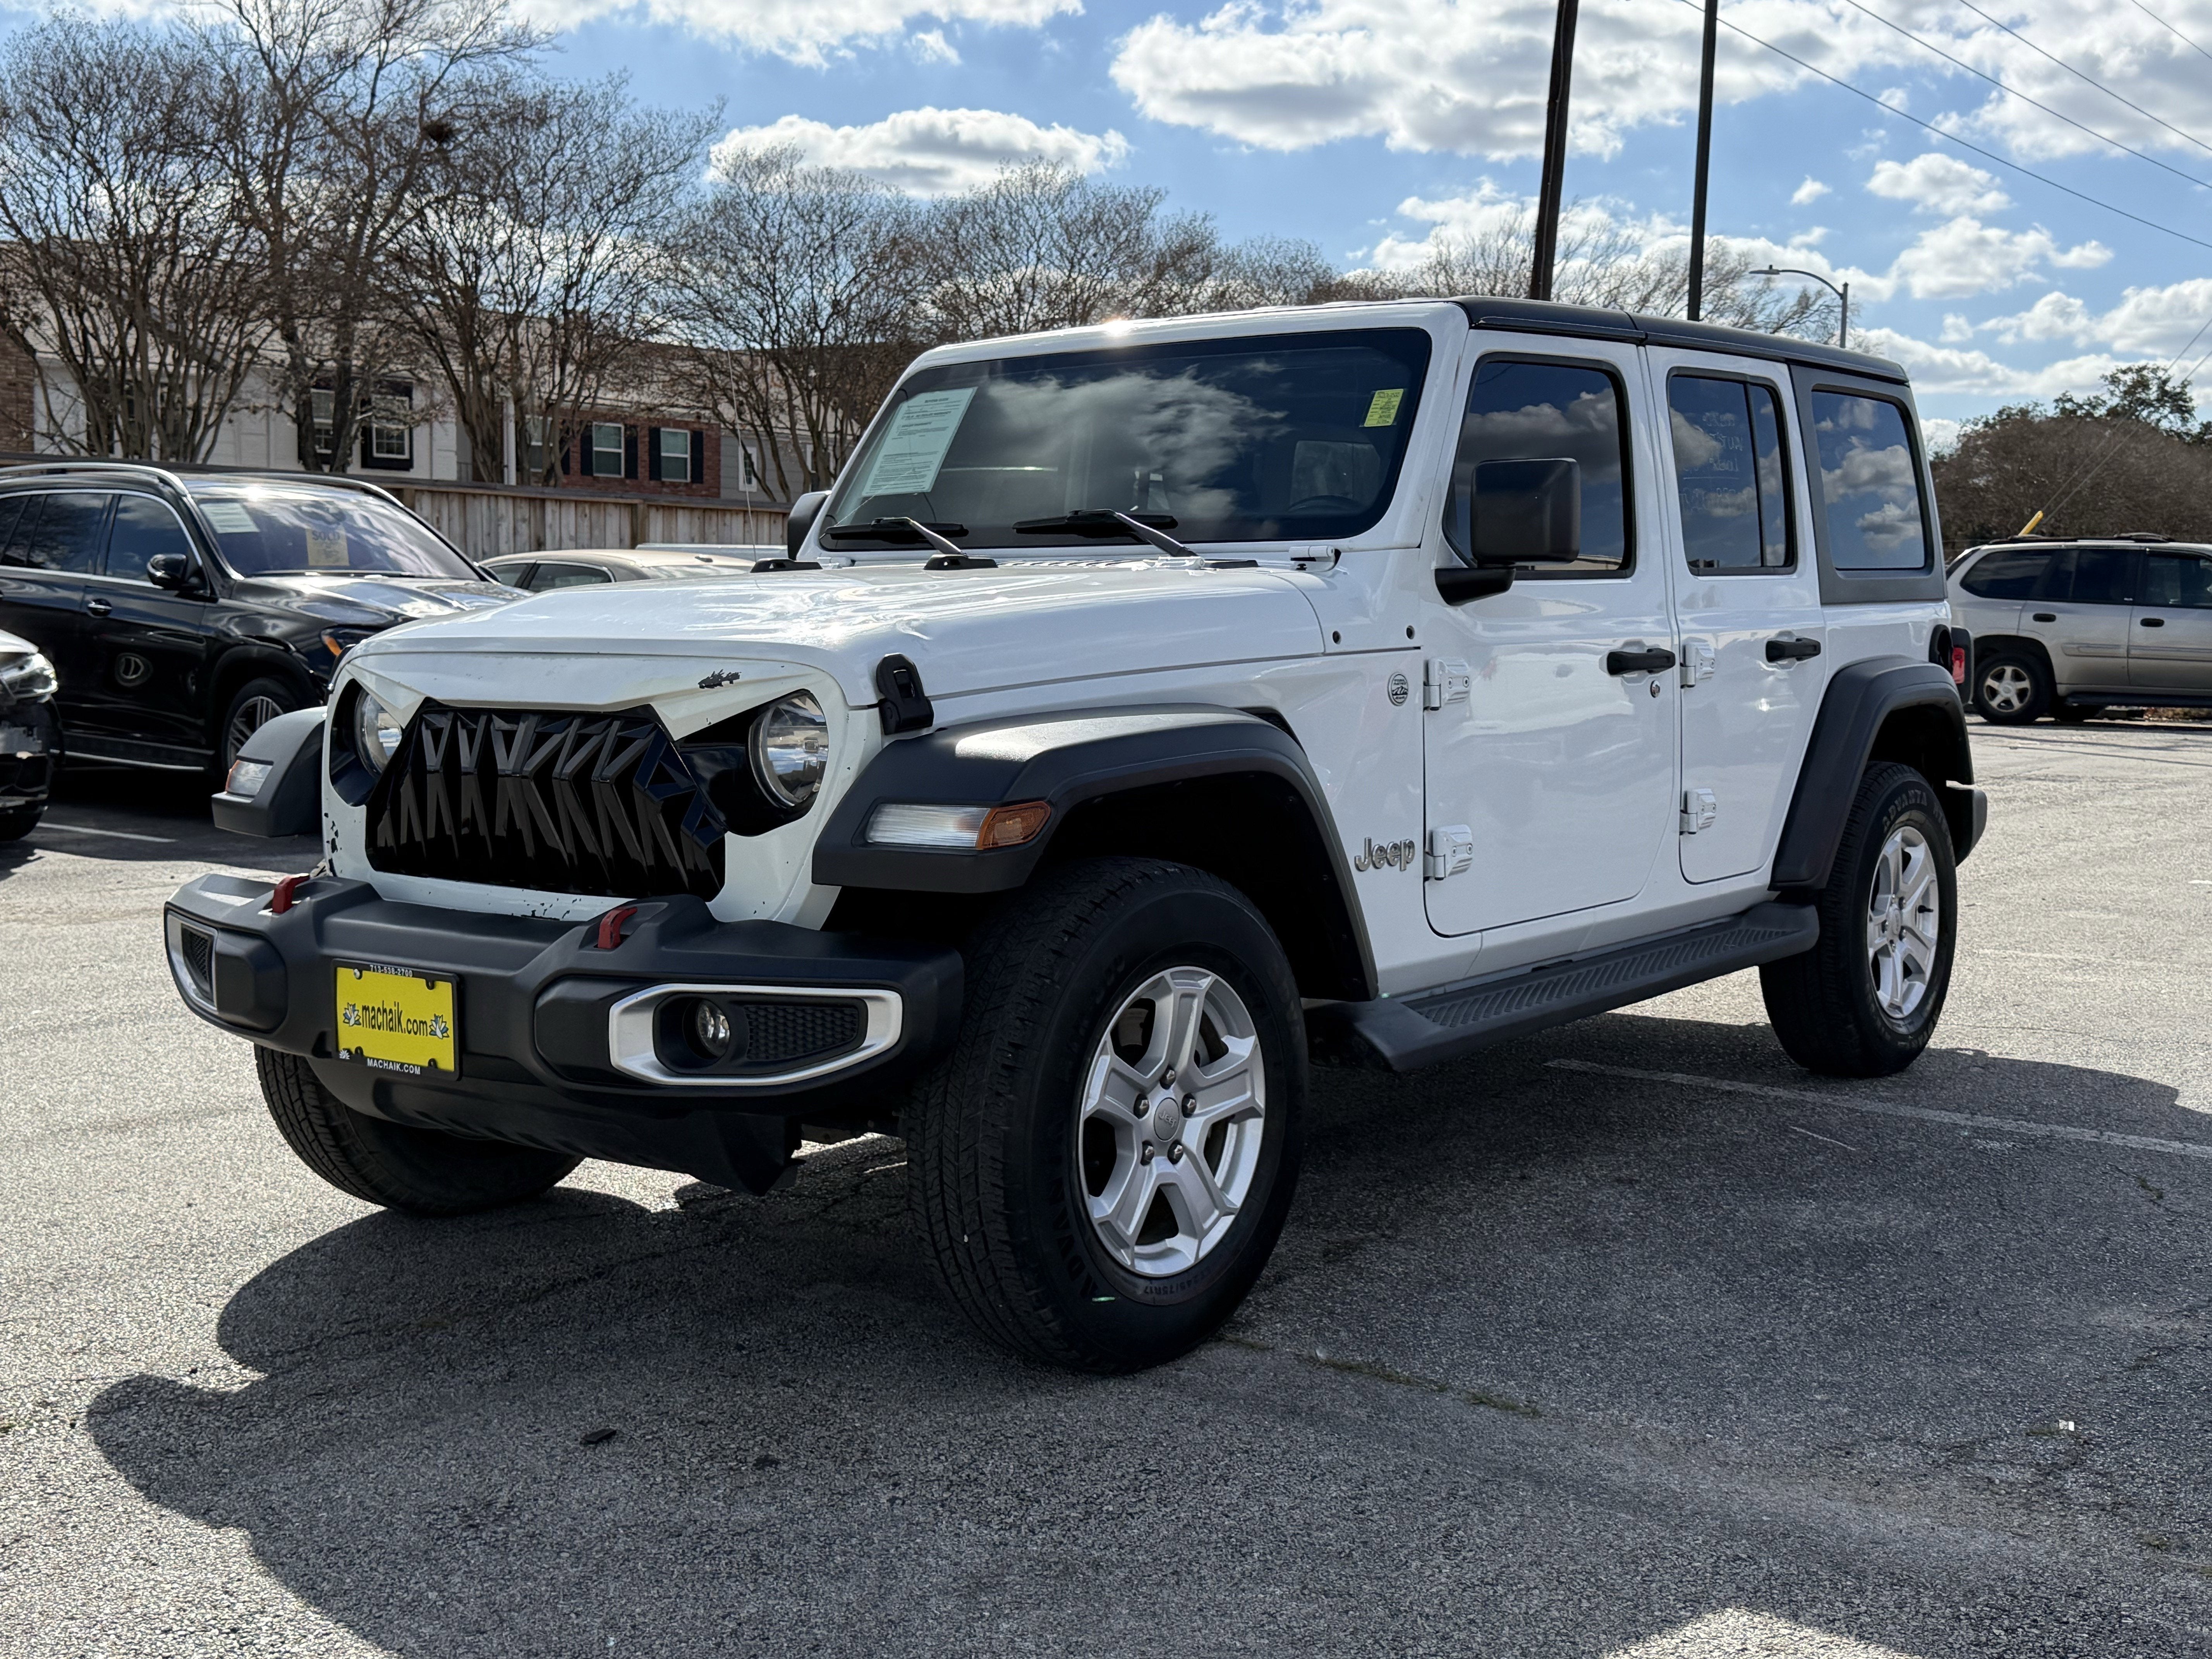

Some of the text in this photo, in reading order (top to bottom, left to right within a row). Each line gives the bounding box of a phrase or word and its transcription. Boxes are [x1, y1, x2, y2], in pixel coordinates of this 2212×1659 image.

[1354, 836, 1415, 872] Jeep
[370, 965, 412, 977] 713-538-2700
[362, 1000, 428, 1037] machaik.com
[367, 1058, 421, 1075] MACHAIK.COM
[1158, 1110, 1176, 1128] Jeep
